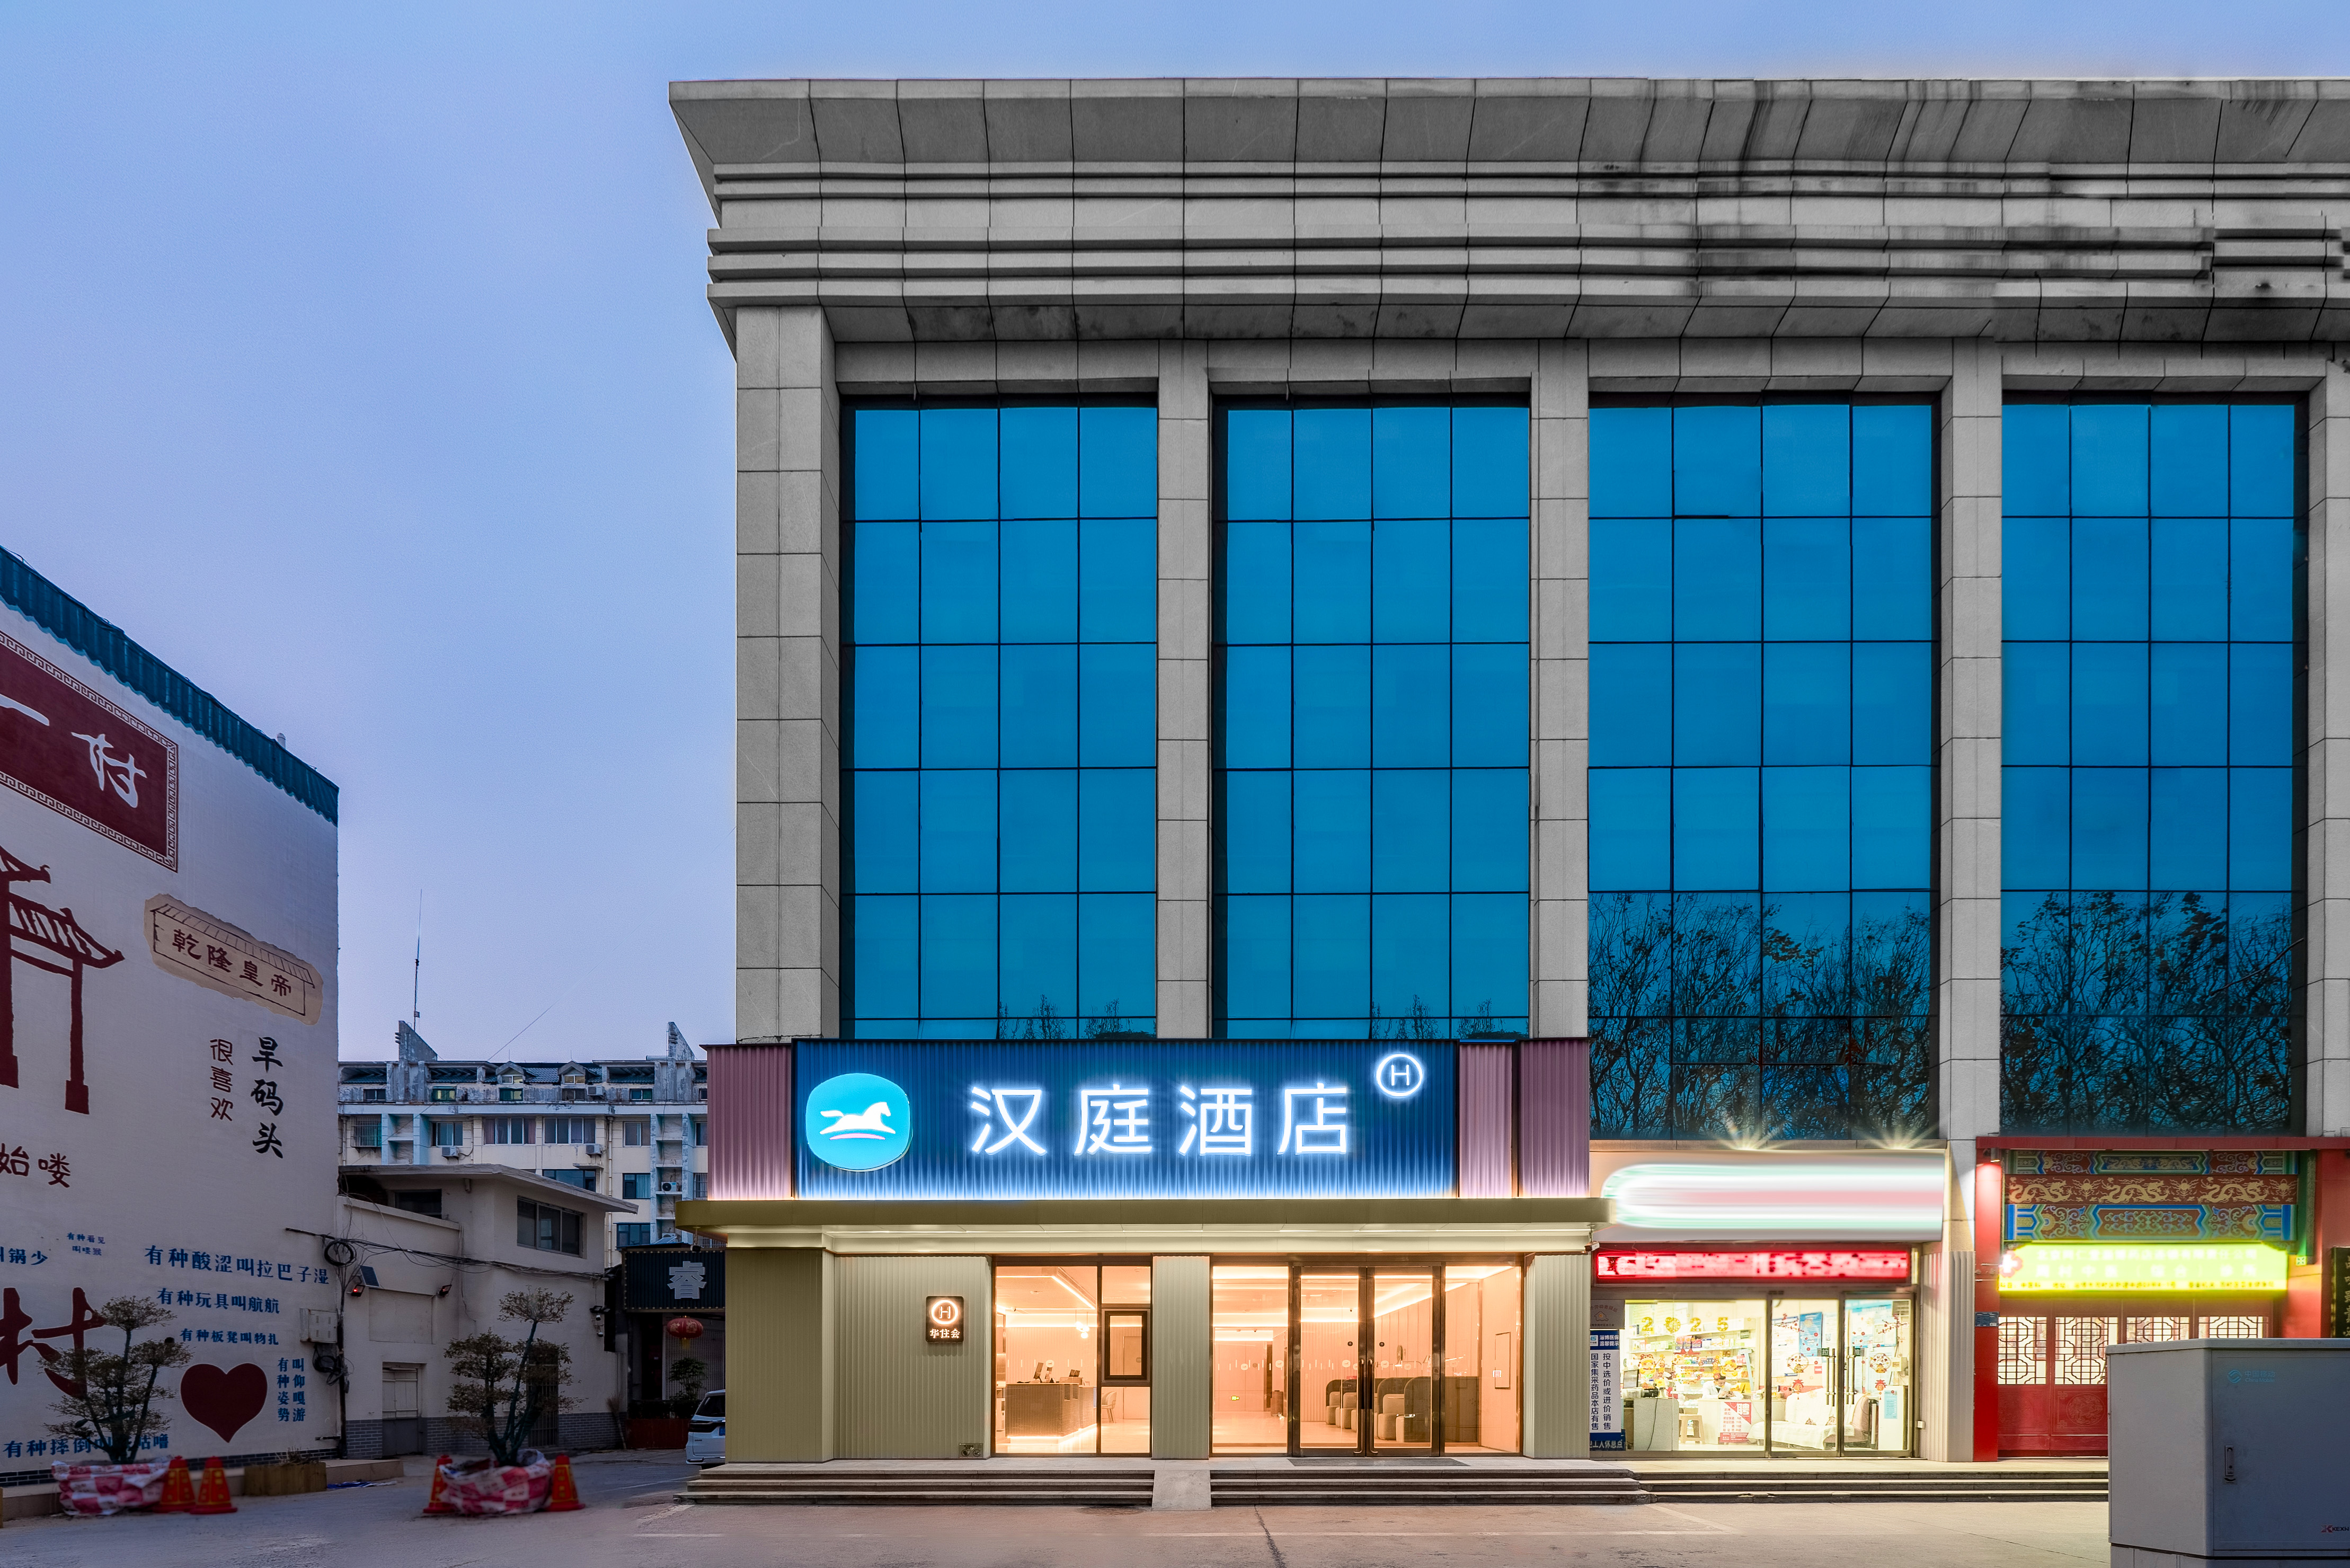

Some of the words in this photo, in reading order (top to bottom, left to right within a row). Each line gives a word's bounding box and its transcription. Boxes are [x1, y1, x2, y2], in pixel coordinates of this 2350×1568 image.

[172, 929, 291, 997] 乾隆皇帝
[210, 1039, 233, 1121] 很喜欢
[251, 1037, 283, 1158] 旱码头
[971, 1083, 1346, 1156] 汉庭酒店
[0, 1246, 48, 1265] 锅少
[67, 1232, 105, 1244] 有种看见
[144, 1245, 329, 1284] 有种酸涩叫拉巴子湿
[157, 1288, 280, 1314] 有种玩具叫航航
[180, 1328, 279, 1345] 有种板凳叫物扎
[929, 1327, 960, 1339] 华住会
[277, 1357, 290, 1422] 有种姿势
[1603, 1353, 1611, 1430] 按中选价或进价销售
[1736, 1403, 1750, 1415] 聘
